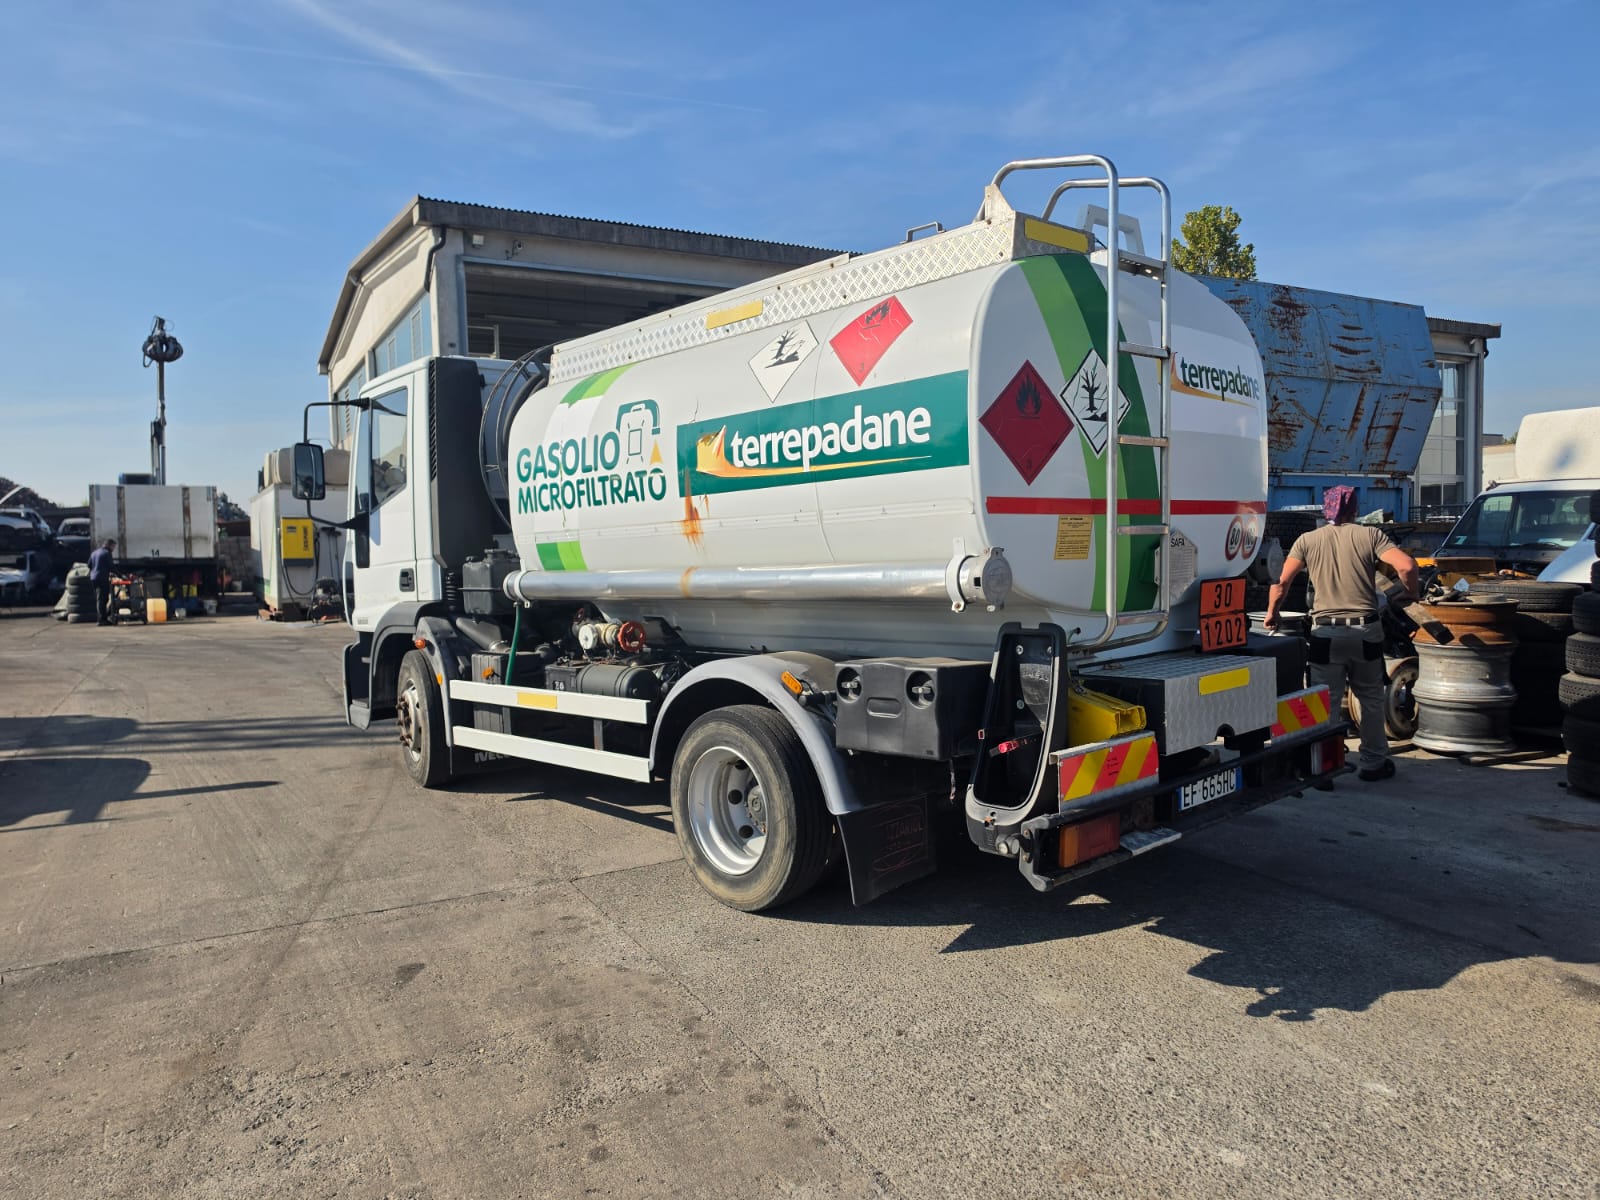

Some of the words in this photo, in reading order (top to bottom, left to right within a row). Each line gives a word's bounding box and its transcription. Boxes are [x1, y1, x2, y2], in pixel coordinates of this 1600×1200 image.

[1180, 356, 1260, 401] terrepadane
[516, 431, 621, 483] GASOLIO
[730, 404, 932, 472] terrepadane
[518, 467, 667, 515] MICROFILTRATO
[1230, 527, 1241, 546] 80
[1214, 582, 1233, 609] 30
[1205, 617, 1243, 648] 1202
[1183, 783, 1198, 808] EF
